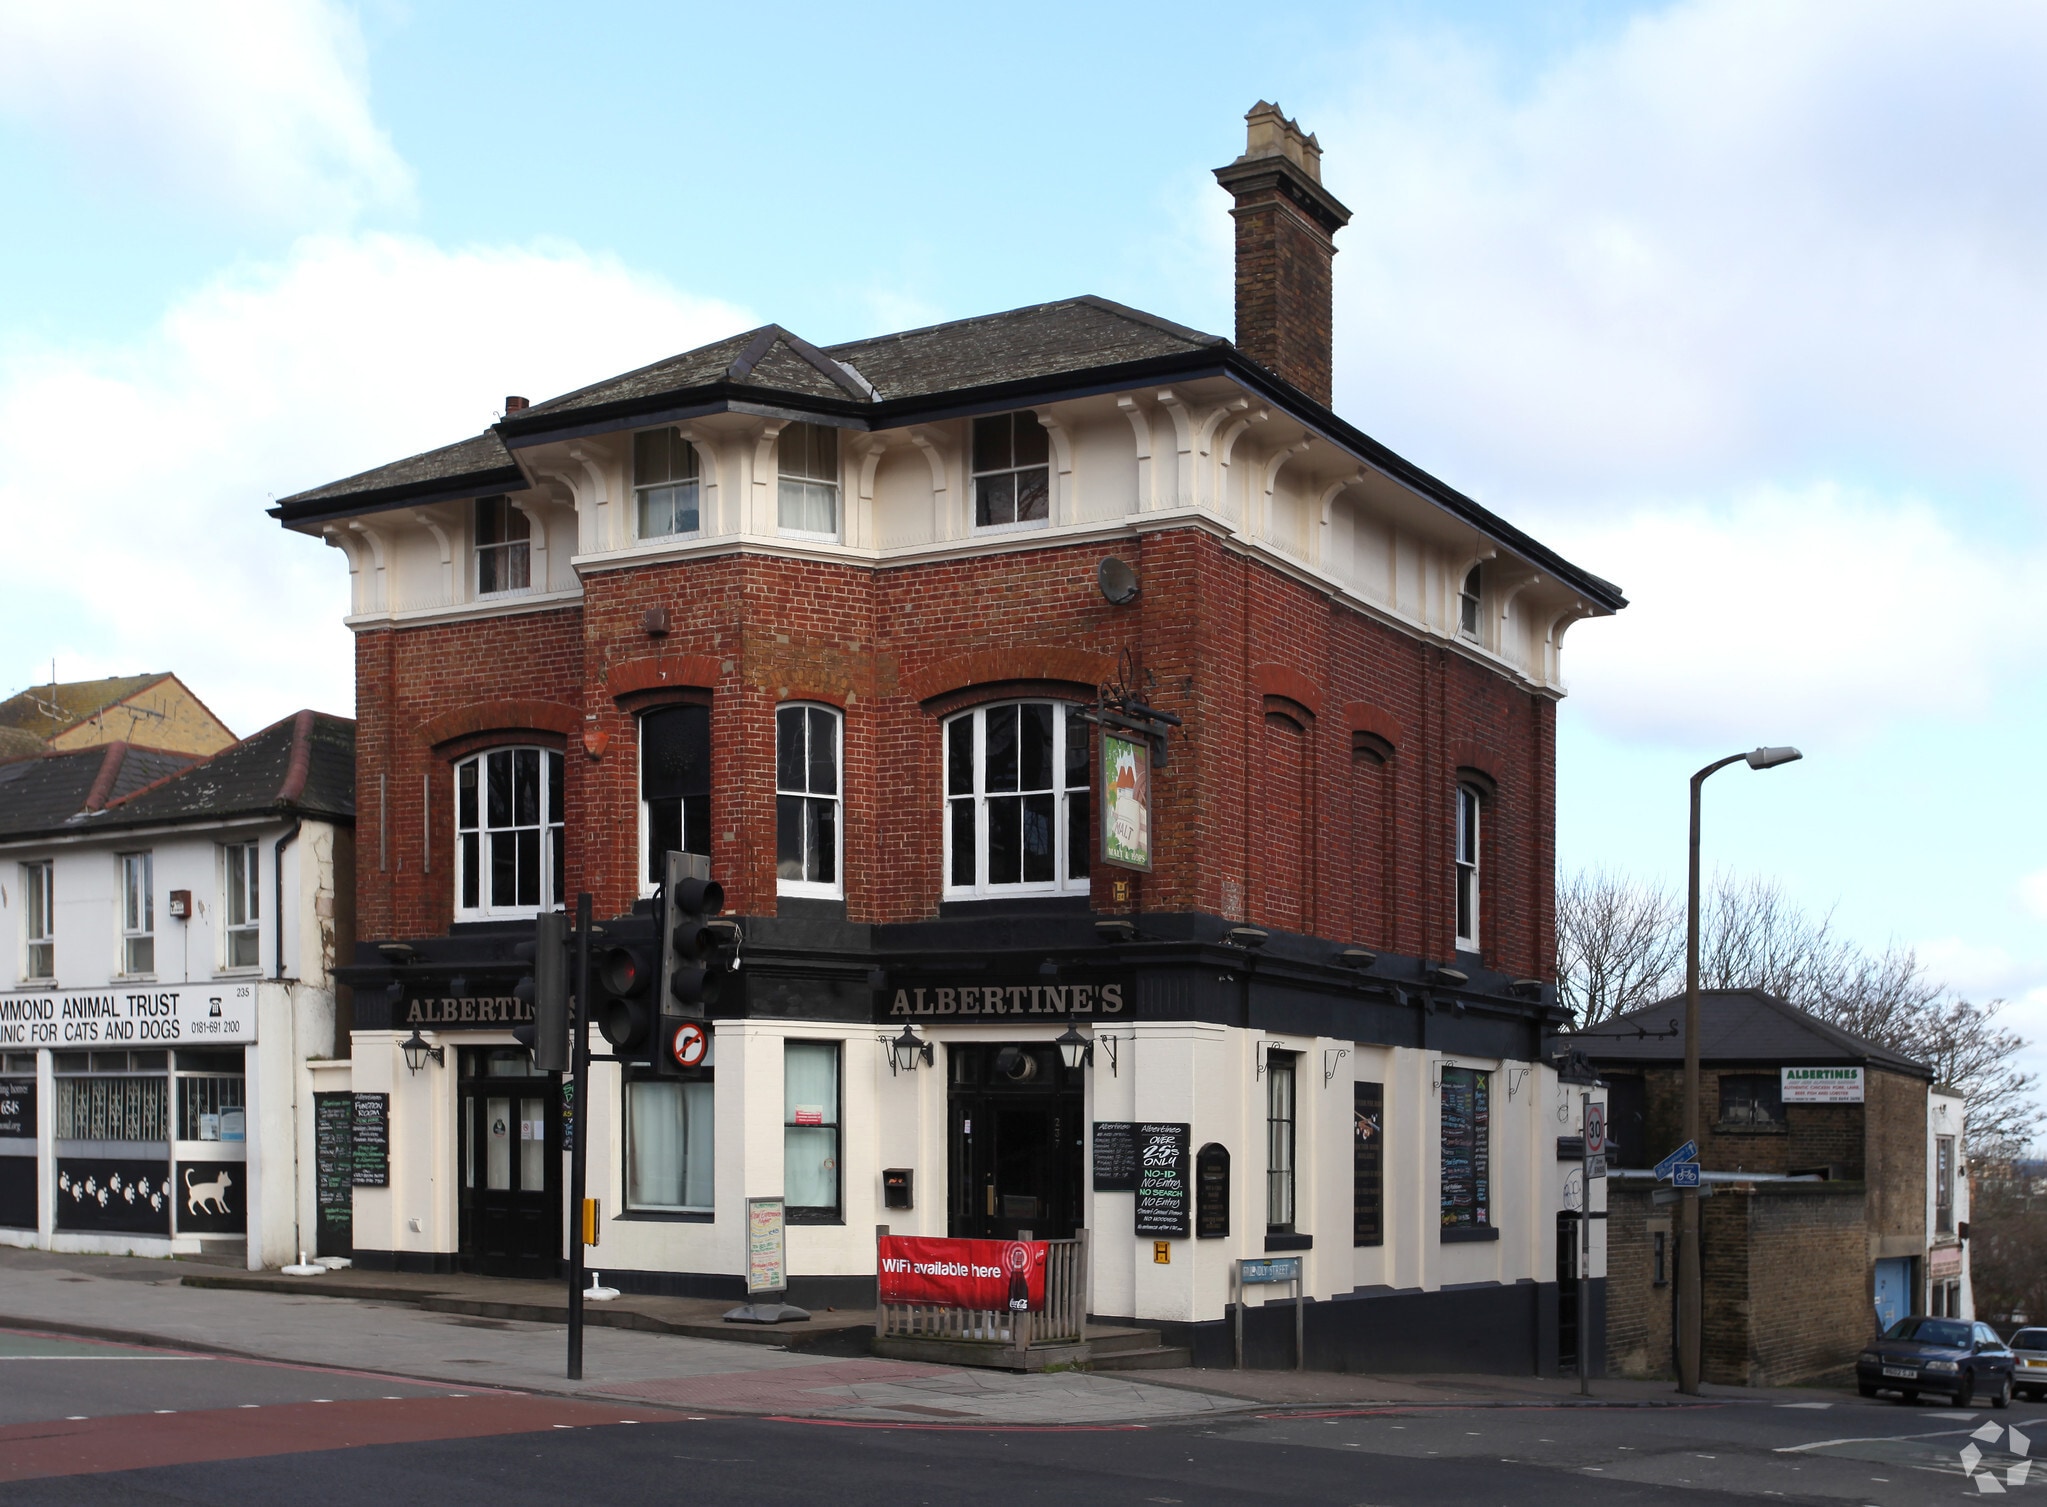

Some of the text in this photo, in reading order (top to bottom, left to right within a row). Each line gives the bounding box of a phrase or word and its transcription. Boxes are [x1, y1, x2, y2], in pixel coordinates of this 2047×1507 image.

[1114, 821, 1134, 841] MALT
[1108, 847, 1123, 859] MALT
[236, 987, 250, 998] 235
[890, 983, 1124, 1015] ALBERTINE'S
[62, 996, 121, 1019] ANIMAL
[126, 993, 180, 1017] TRUST
[406, 996, 536, 1022] ALBERTI
[31, 1023, 58, 1042] FOR
[64, 1022, 99, 1042] CATS
[105, 1020, 134, 1040] AND
[140, 1019, 180, 1040] DOGS
[223, 1020, 240, 1033] 2100
[1787, 1069, 1858, 1080] ALBERTINES
[1589, 1121, 1601, 1138] 30
[1150, 1135, 1176, 1144] OVER
[1142, 1144, 1180, 1158] 25's
[1143, 1156, 1177, 1168] ONLY
[1144, 1169, 1177, 1178] NO-ID
[1141, 1178, 1156, 1187] NO
[1140, 1188, 1183, 1197] NO SEARCH
[1141, 1197, 1180, 1209] NO Entry
[1156, 1243, 1168, 1261] H
[882, 1258, 1001, 1278] WiFi available here
